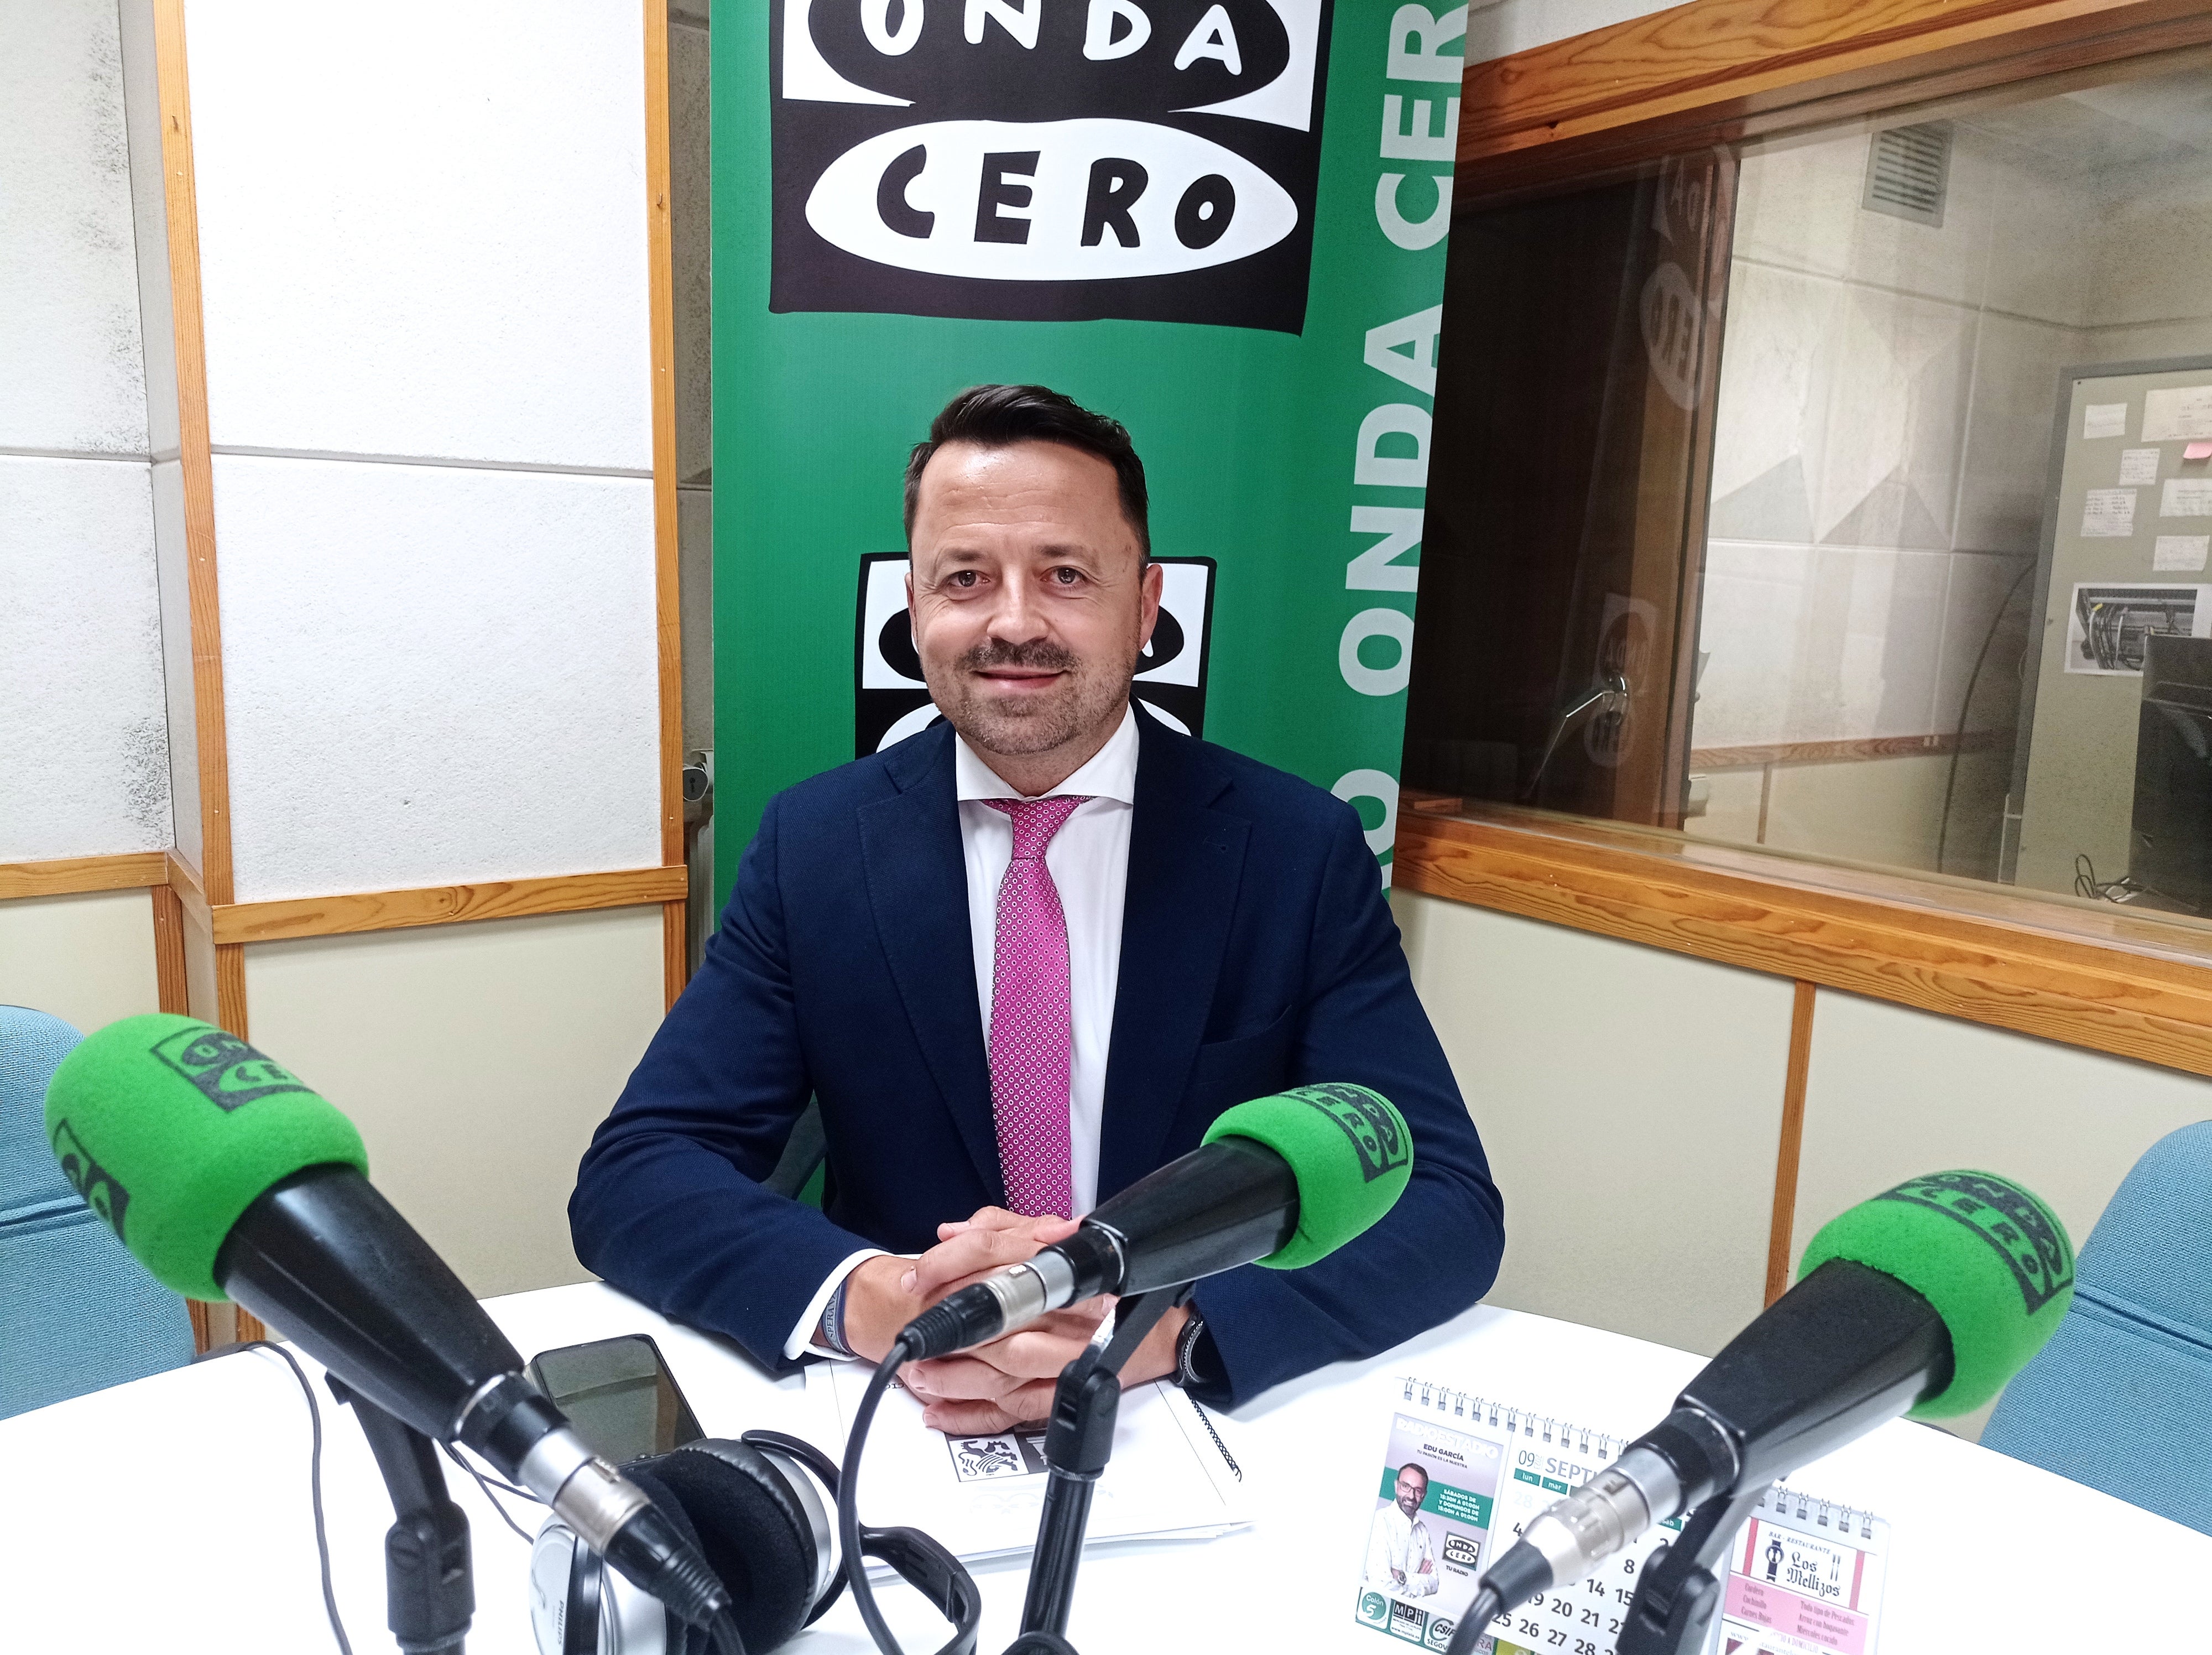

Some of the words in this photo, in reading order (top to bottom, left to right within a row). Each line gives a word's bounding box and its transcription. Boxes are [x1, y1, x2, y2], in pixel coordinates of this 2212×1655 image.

[860, 0, 1243, 75] ONDA
[877, 143, 1235, 249] CERO
[1338, 303, 1443, 696] ONDA
[1423, 1444, 1437, 1453] EDU
[1439, 1448, 1464, 1461] GARCÍA
[1519, 1450, 1535, 1467] 09
[1449, 1459, 1467, 1469] NUESTRA
[1522, 1472, 1533, 1482] lun
[1548, 1481, 1562, 1491] mar
[1443, 1489, 1468, 1501] SÁBADOS
[1443, 1500, 1471, 1513] DOMINGOS
[1450, 1539, 1474, 1552] ONDA
[1512, 1522, 1523, 1537] 4
[1624, 1559, 1635, 1574] 8
[1768, 1531, 1782, 1539] BAR
[1786, 1537, 1831, 1554] RESTAURANTE
[1450, 1551, 1471, 1562] CERO
[1791, 1552, 1818, 1572] Los
[1453, 1567, 1468, 1576] RADIO
[1786, 1568, 1841, 1597] Mellizos
[1366, 1595, 1384, 1606] Colón
[1587, 1578, 1605, 1597] 14
[1615, 1588, 1634, 1606] 15
[1365, 1604, 1377, 1617] 5
[1551, 1598, 1573, 1617] 20
[1580, 1609, 1600, 1628] 21
[1608, 1618, 1625, 1635] 2
[1491, 1612, 1512, 1627] 25
[1519, 1618, 1540, 1637] 26
[1547, 1629, 1567, 1647] 27
[1574, 1638, 1596, 1655] 28
[1427, 1638, 1448, 1651] SEGOV
